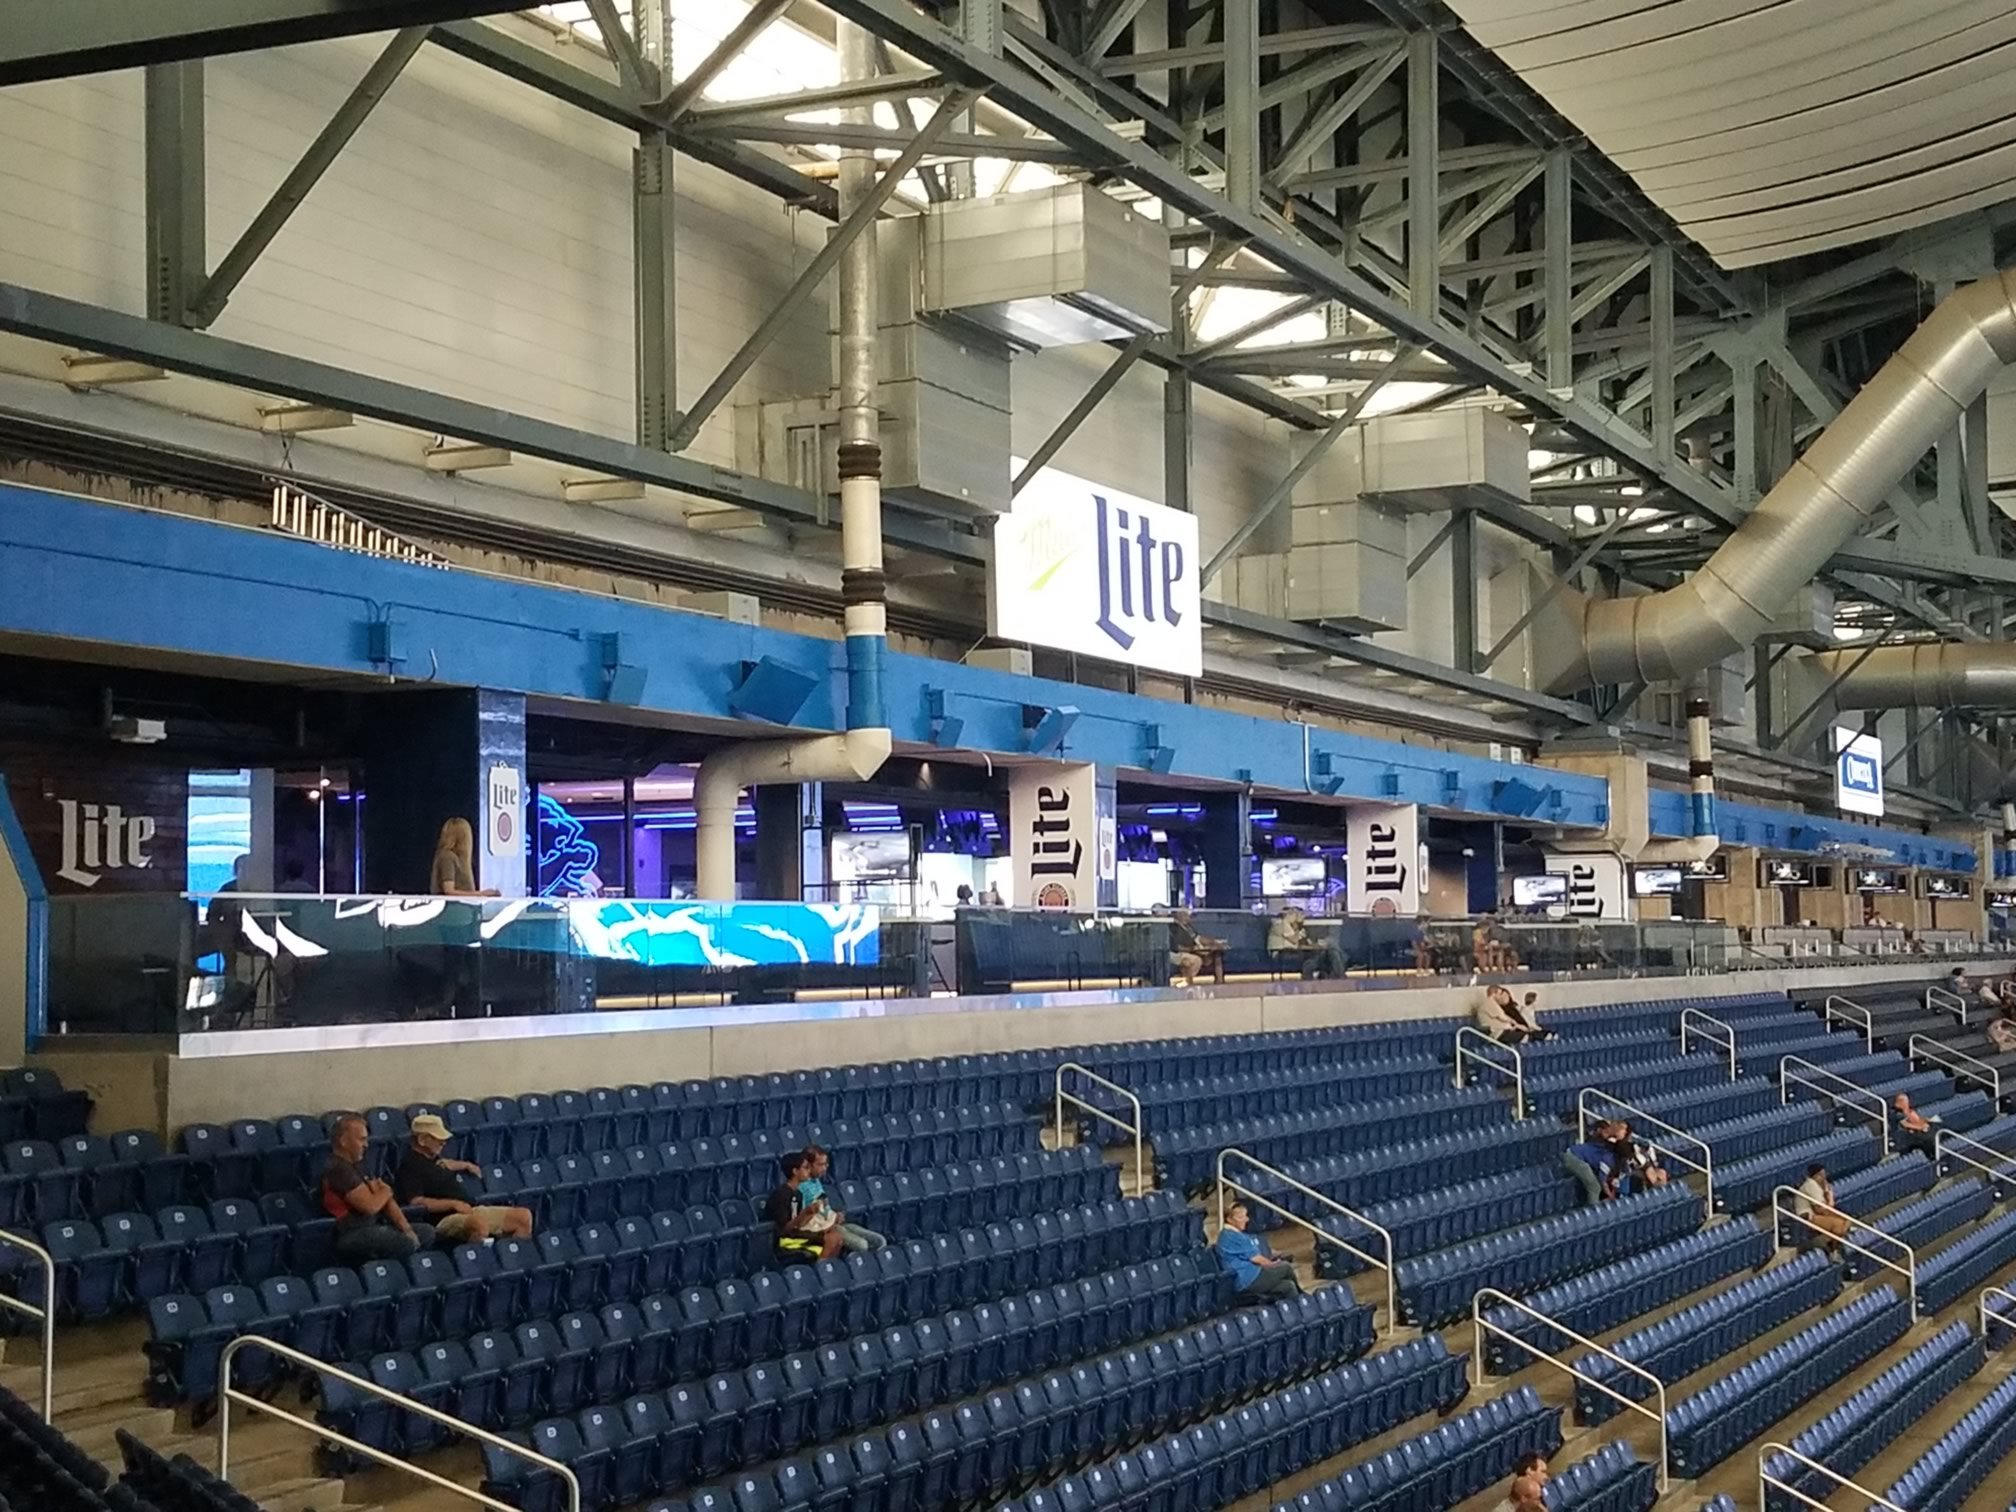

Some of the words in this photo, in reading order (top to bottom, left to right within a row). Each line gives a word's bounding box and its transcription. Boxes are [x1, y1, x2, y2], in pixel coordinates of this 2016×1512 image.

[1091, 493, 1184, 652] Lite
[493, 783, 517, 809] Lite
[1031, 786, 1082, 880] Lite
[56, 799, 155, 887] Lite
[1366, 823, 1407, 894] Lite
